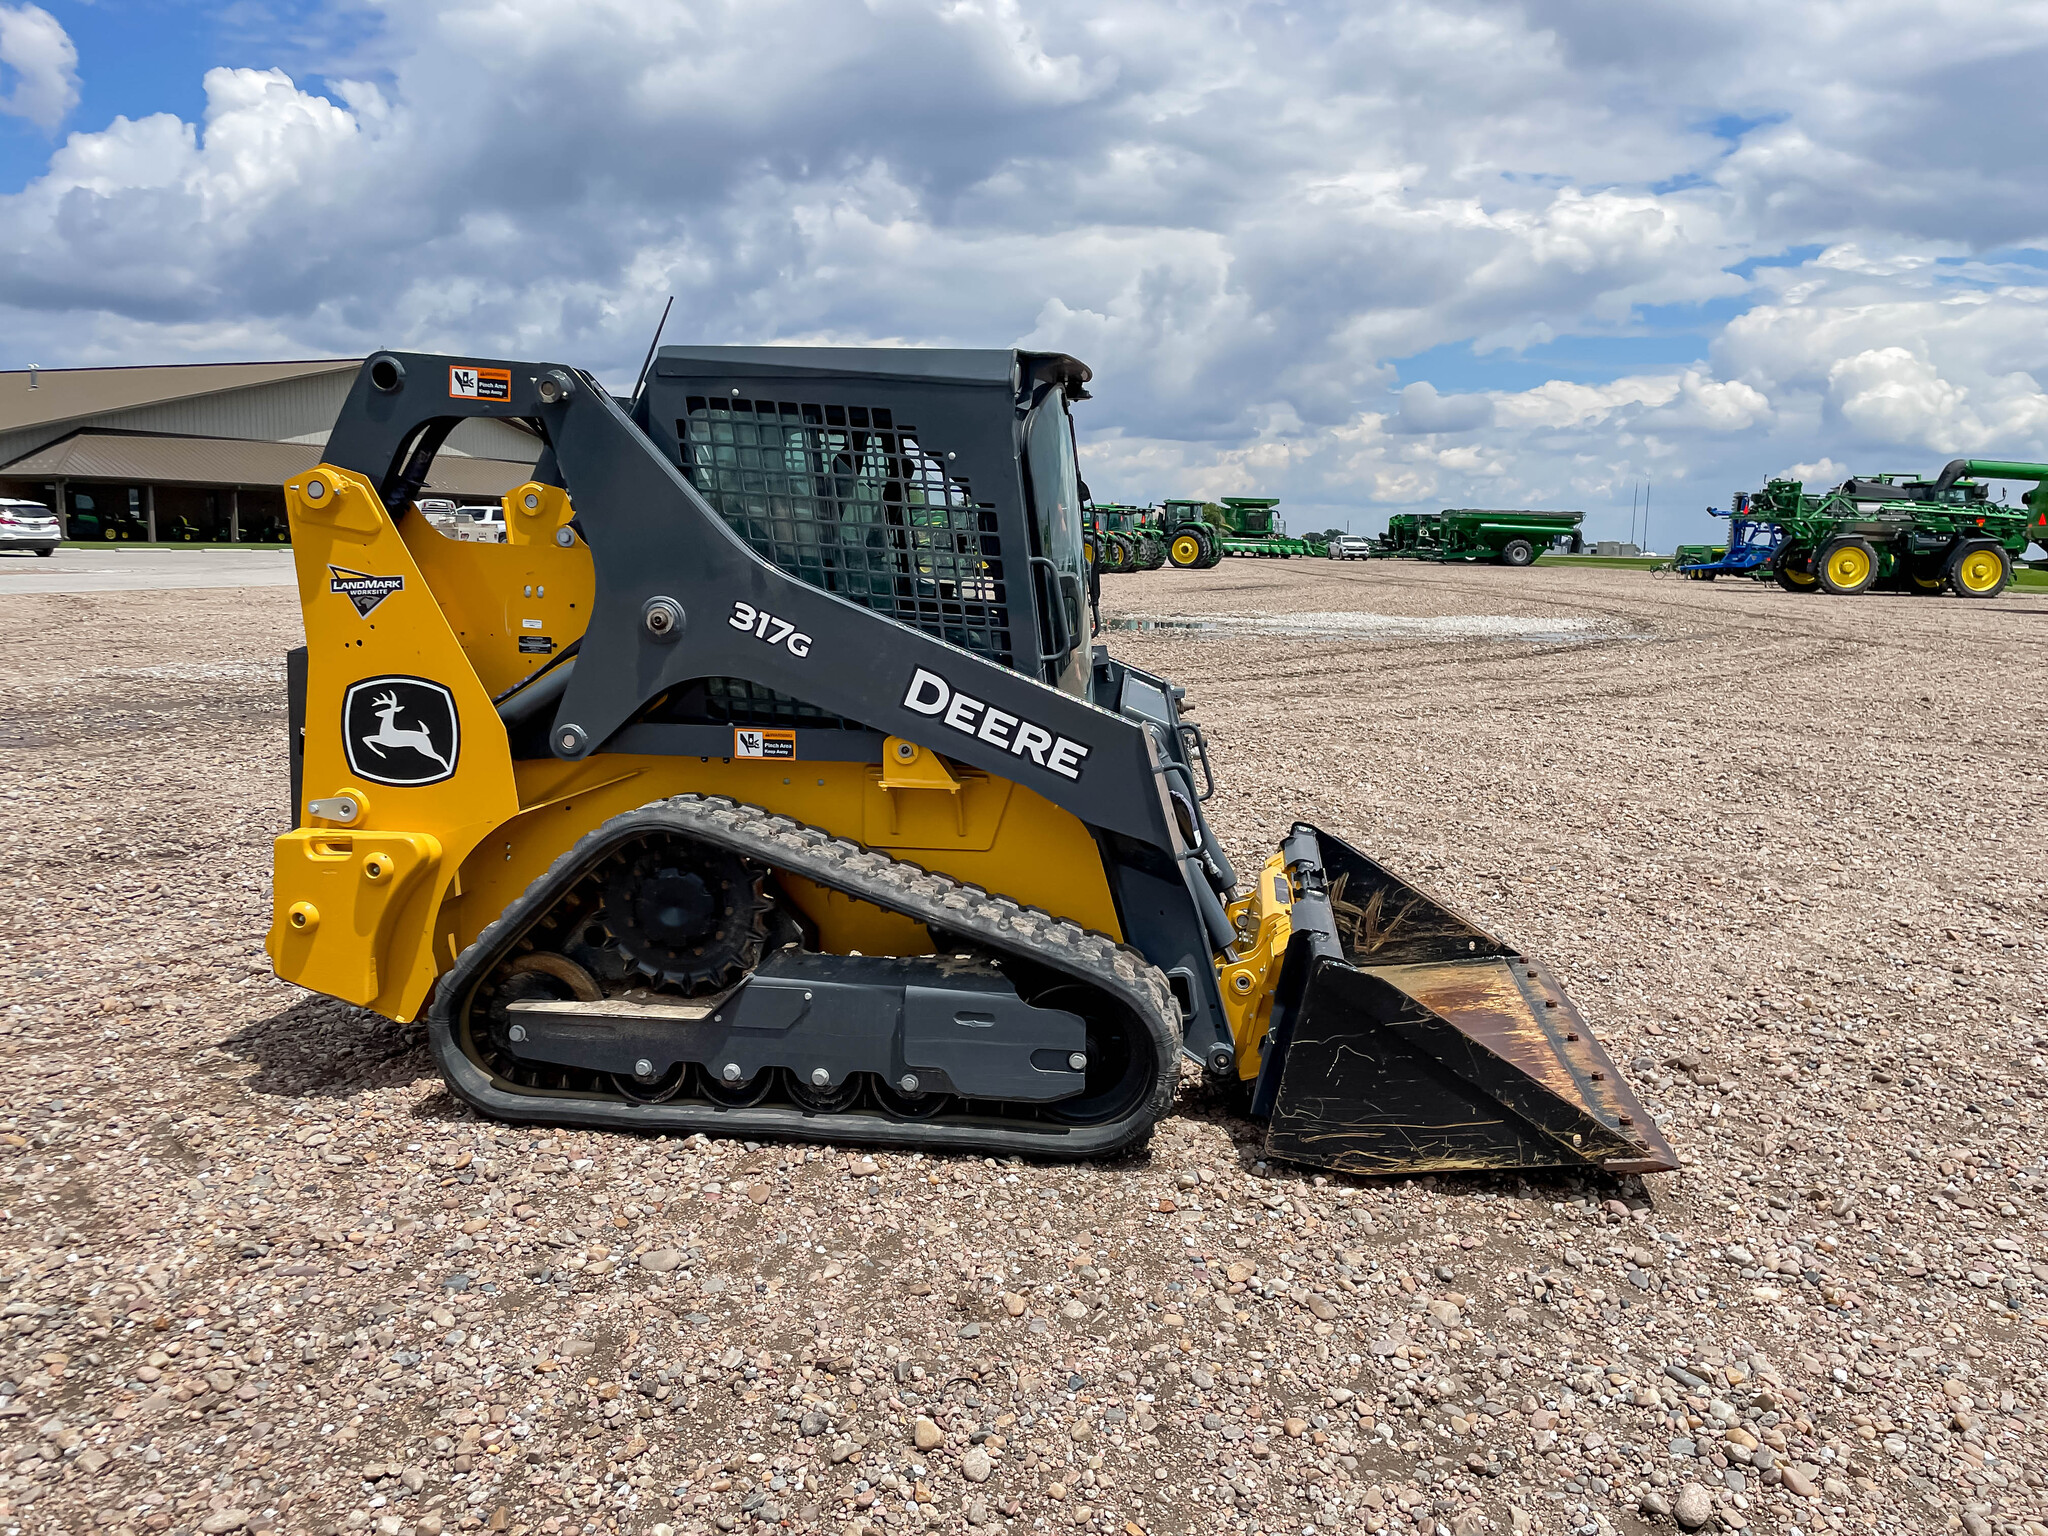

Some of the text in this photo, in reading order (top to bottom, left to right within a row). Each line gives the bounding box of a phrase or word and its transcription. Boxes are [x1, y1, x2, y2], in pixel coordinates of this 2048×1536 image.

[333, 580, 401, 590] LANDMARK
[728, 602, 812, 658] 317G
[904, 669, 1088, 779] DEERE
